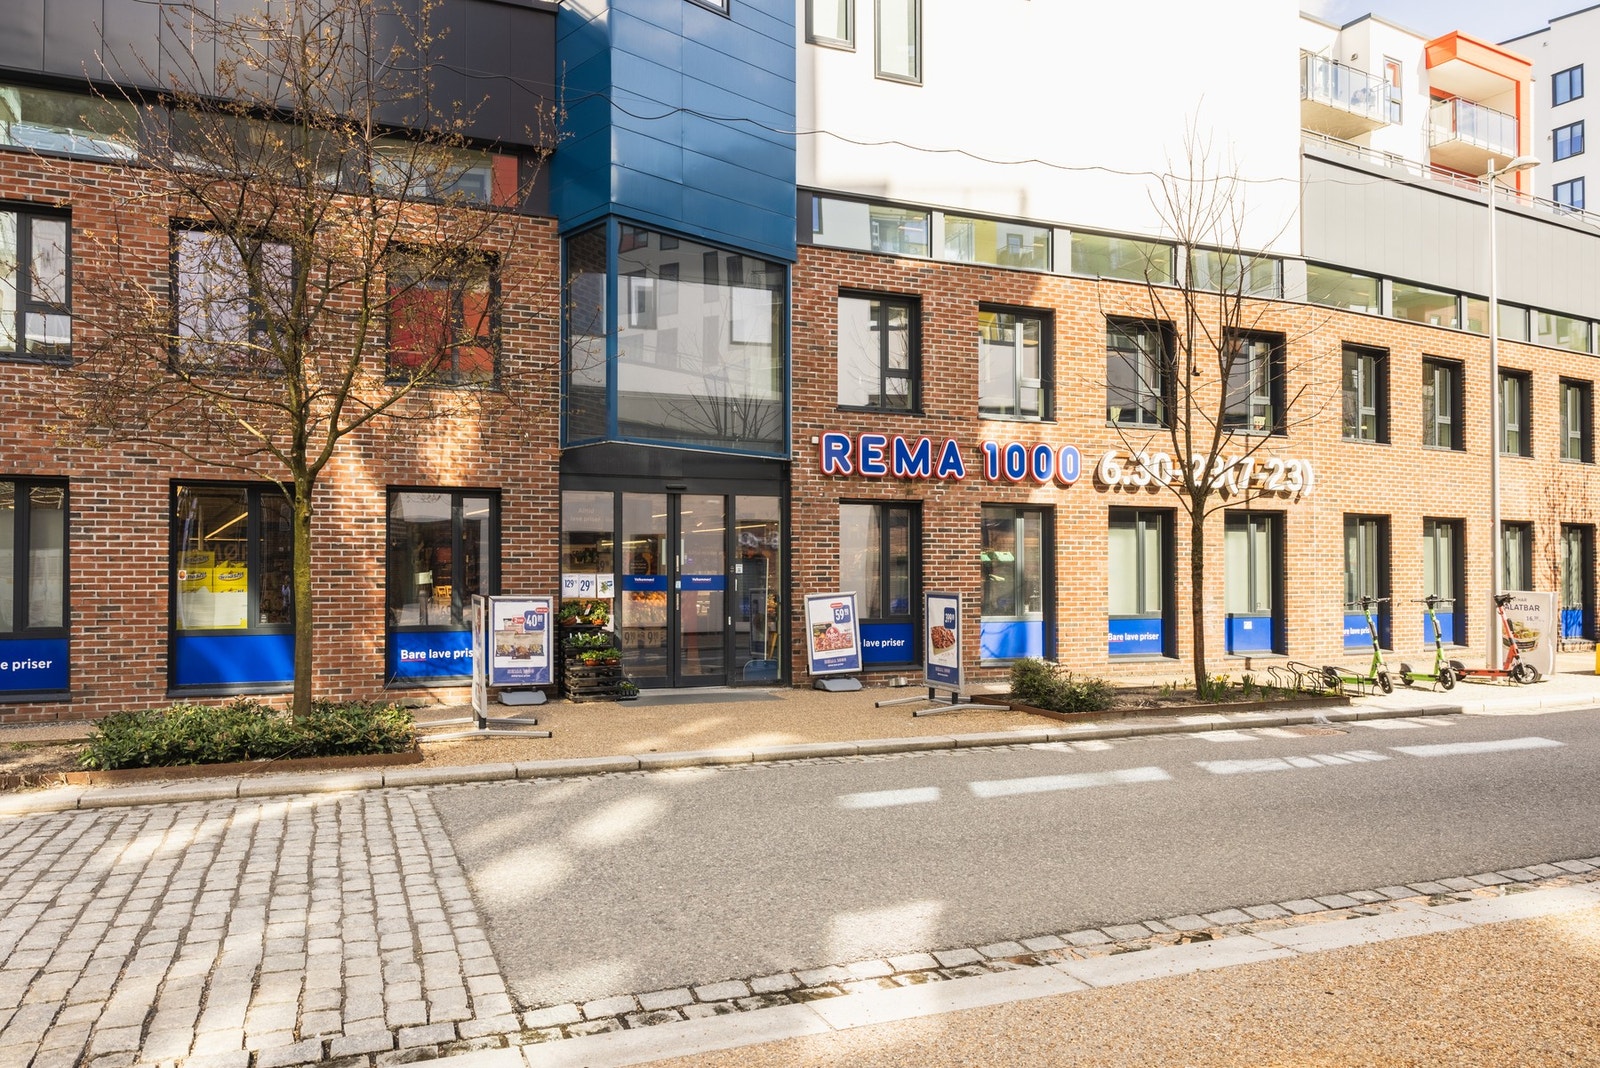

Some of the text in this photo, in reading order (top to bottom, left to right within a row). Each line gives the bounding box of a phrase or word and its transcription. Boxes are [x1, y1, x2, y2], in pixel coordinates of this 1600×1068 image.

[819, 430, 1082, 484] REMA 1000
[580, 580, 590, 591] 29
[1504, 603, 1540, 612] ALATBAR
[526, 614, 537, 627] 40
[835, 608, 844, 621] 59
[863, 637, 905, 648] lave priser
[1108, 631, 1160, 642] Bare lave priser
[400, 647, 473, 660] Bare lave pris
[12, 658, 53, 672] priser
